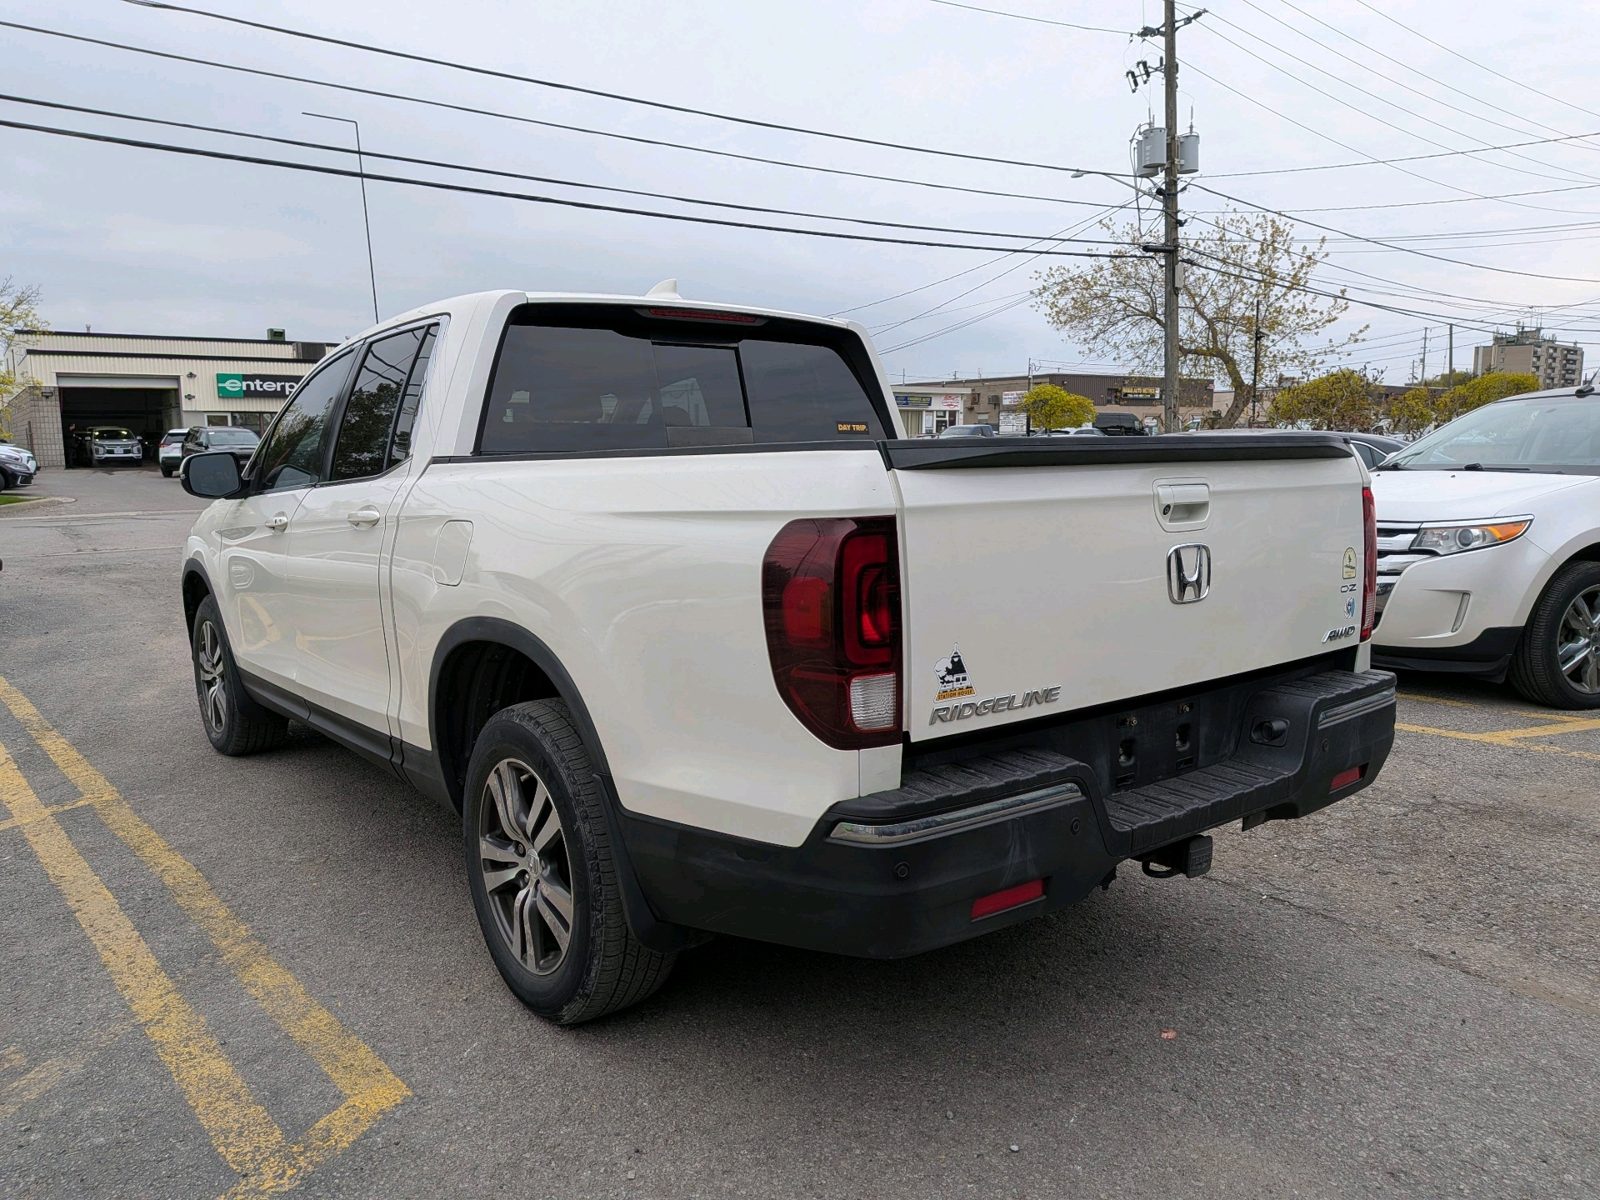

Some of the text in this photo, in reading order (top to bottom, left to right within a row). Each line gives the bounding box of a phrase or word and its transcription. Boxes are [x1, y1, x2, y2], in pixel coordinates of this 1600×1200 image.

[837, 423, 851, 431] DAY
[1322, 625, 1356, 643] AWD
[929, 685, 1061, 725] RIDGELINE
